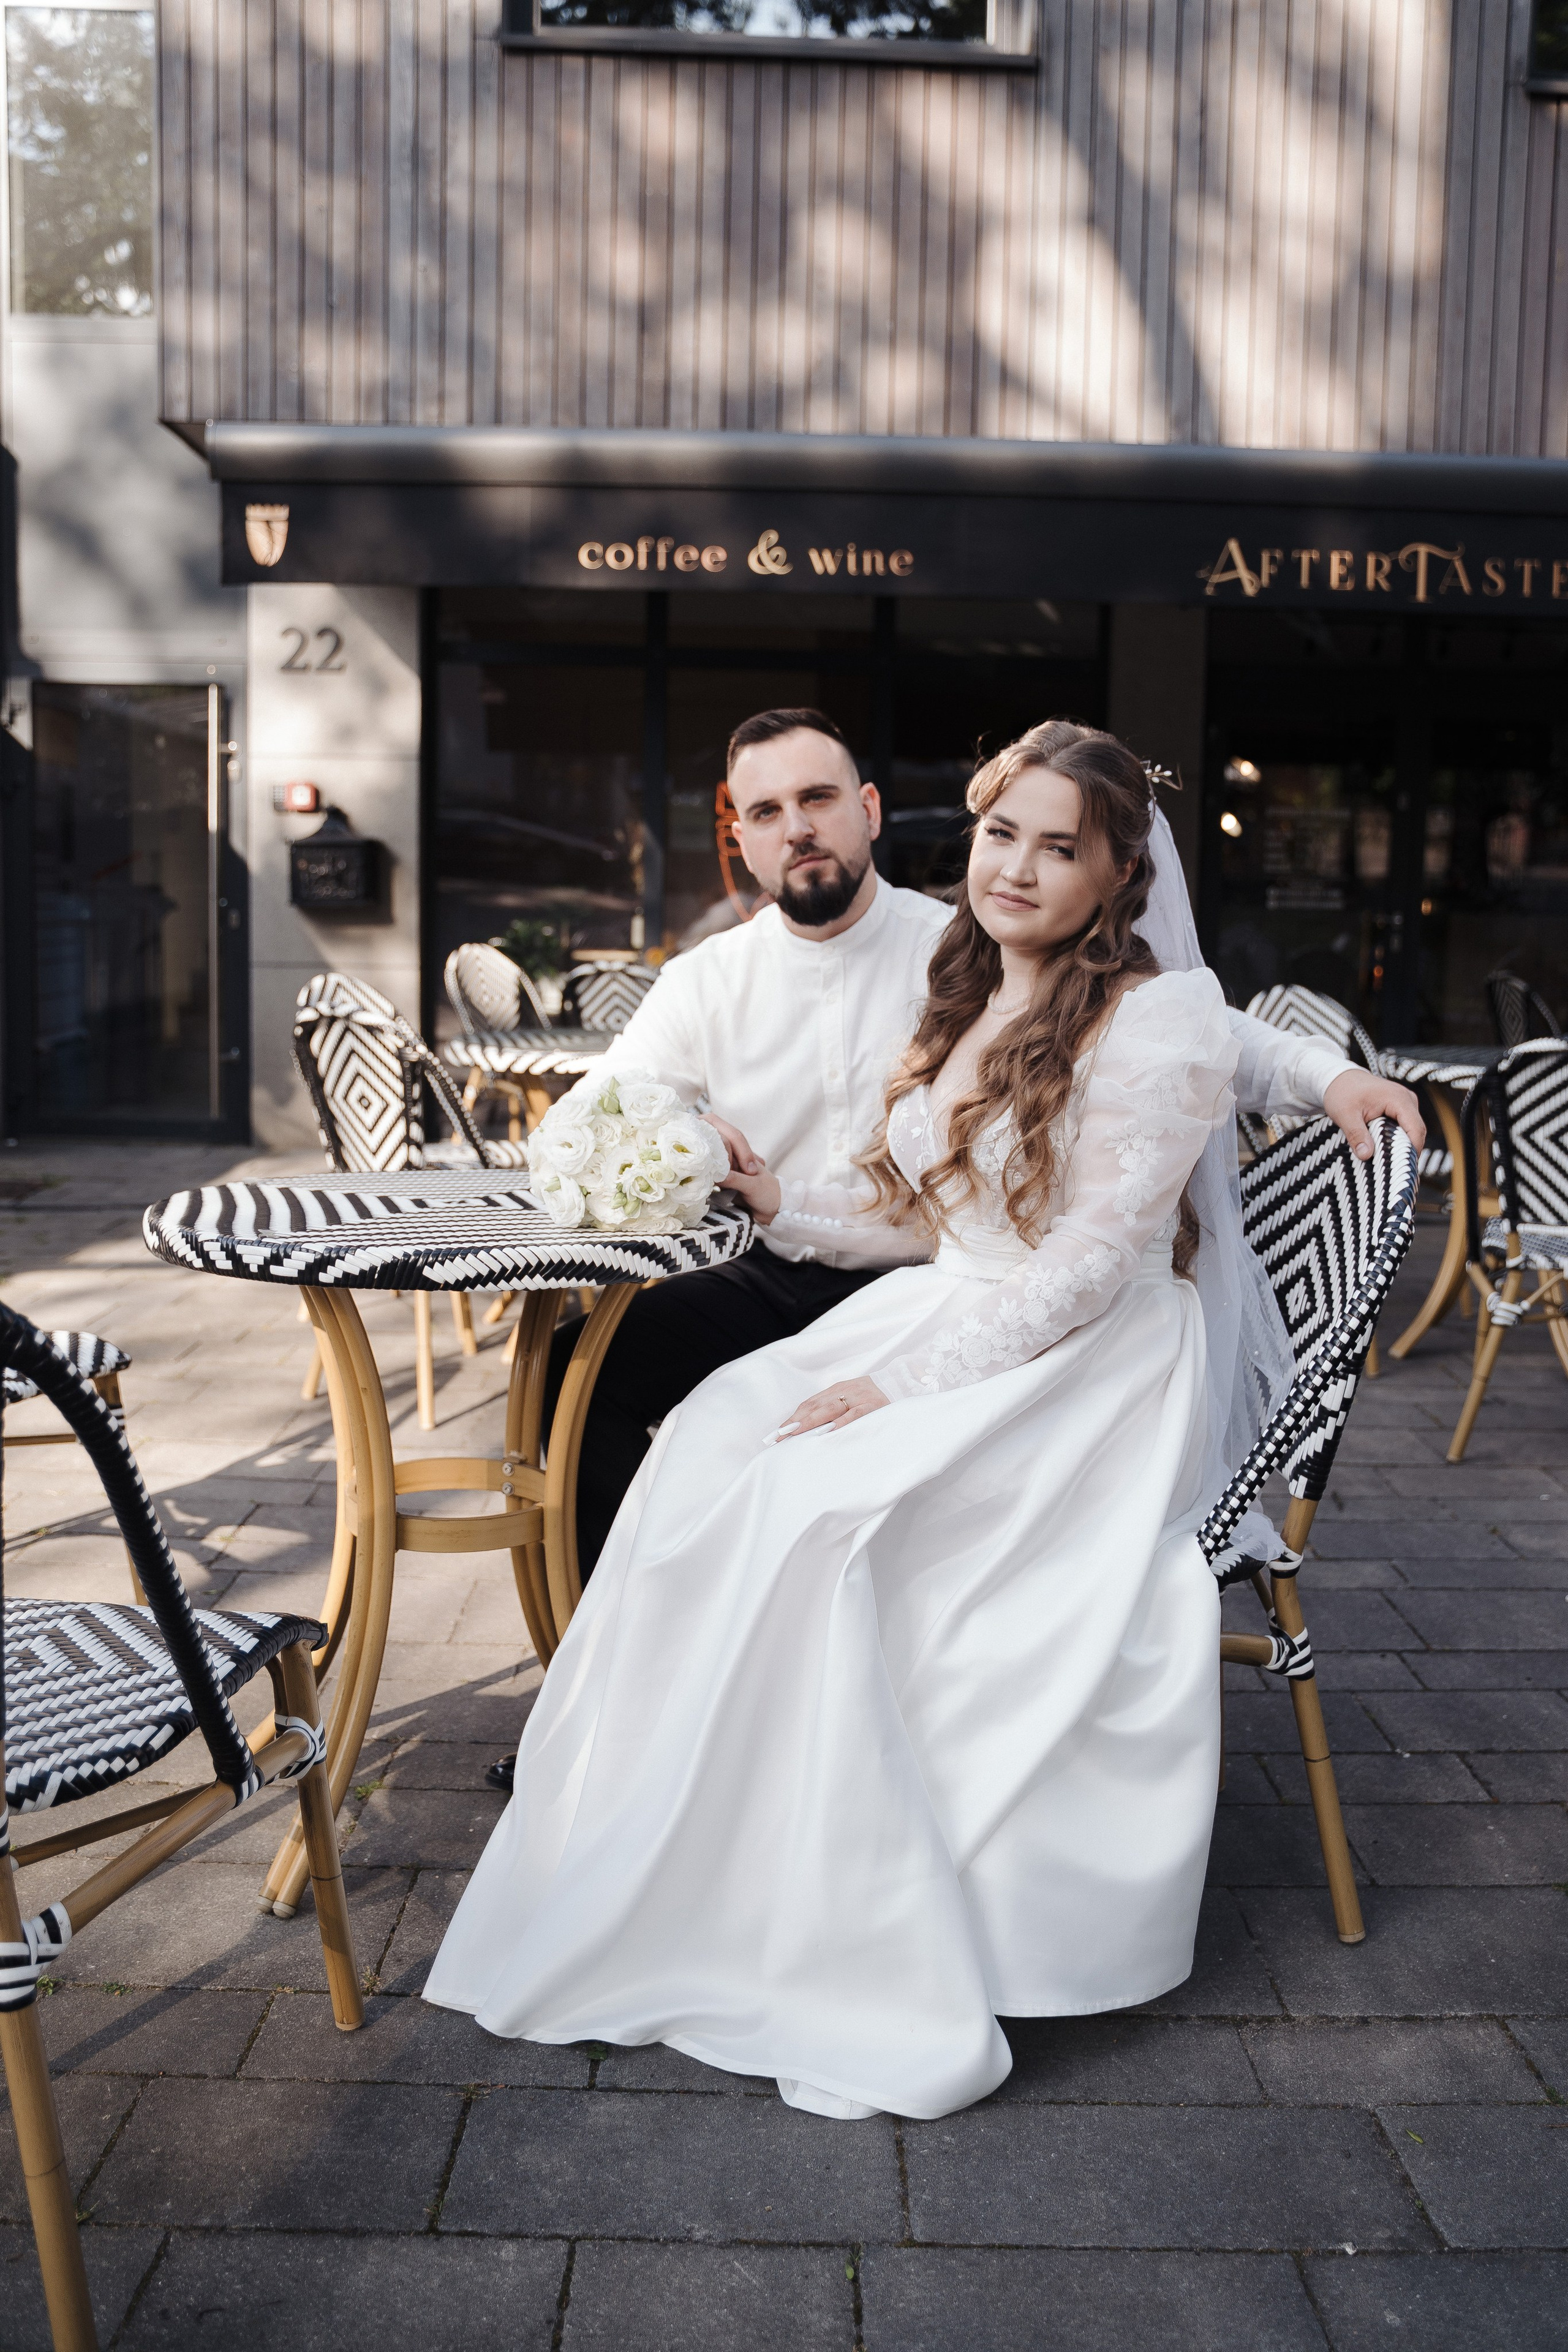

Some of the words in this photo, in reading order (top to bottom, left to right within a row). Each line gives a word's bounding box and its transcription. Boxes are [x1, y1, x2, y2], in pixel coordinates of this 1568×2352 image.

[578, 535, 728, 572] coffee
[747, 529, 793, 575] &
[808, 542, 914, 576] wine
[279, 627, 346, 674] 22
